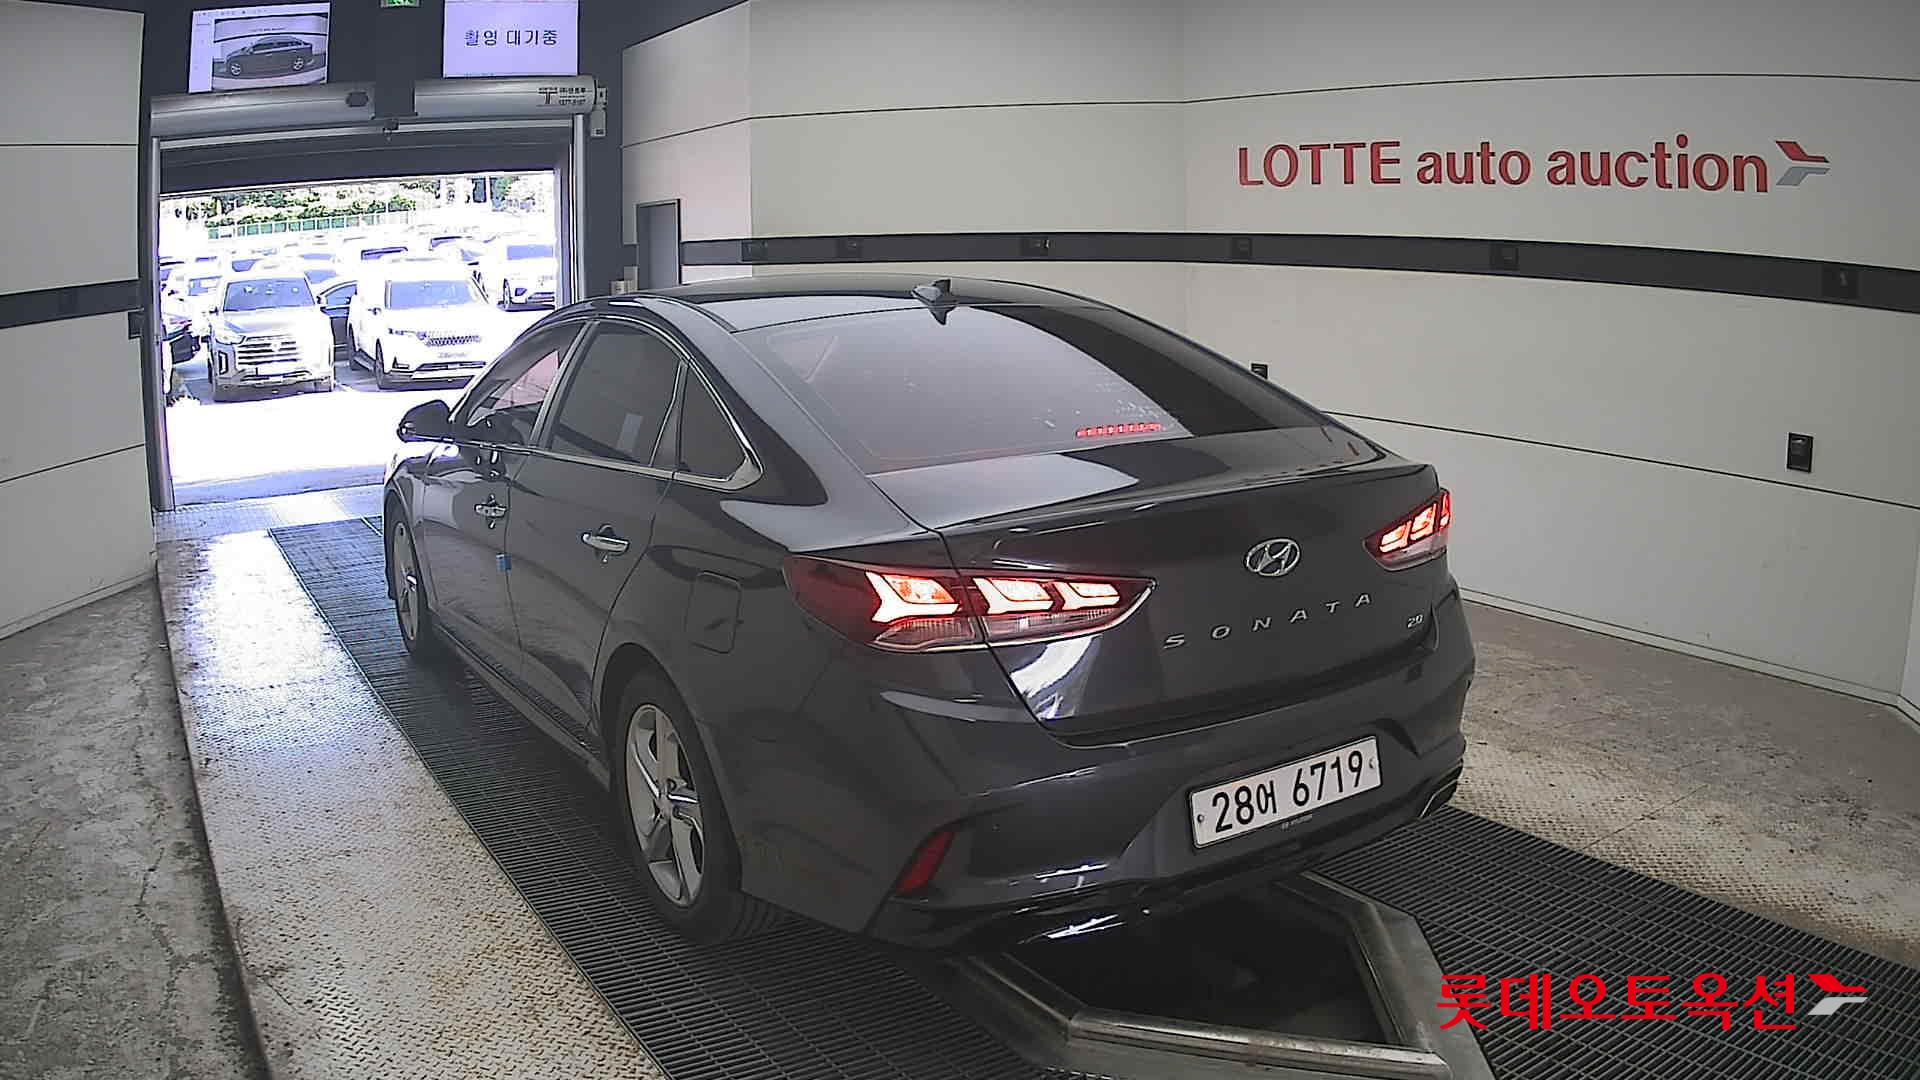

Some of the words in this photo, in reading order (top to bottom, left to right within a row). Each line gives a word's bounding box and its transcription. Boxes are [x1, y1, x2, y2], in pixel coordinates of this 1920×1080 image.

[506, 29, 558, 46] 대기중
[1237, 140, 1401, 188] LOTTE
[1416, 140, 1532, 186] auto
[1546, 133, 1768, 193] auction
[1163, 593, 1372, 649] SONATA
[1211, 780, 1277, 833] 28어
[1292, 750, 1363, 806] 6719
